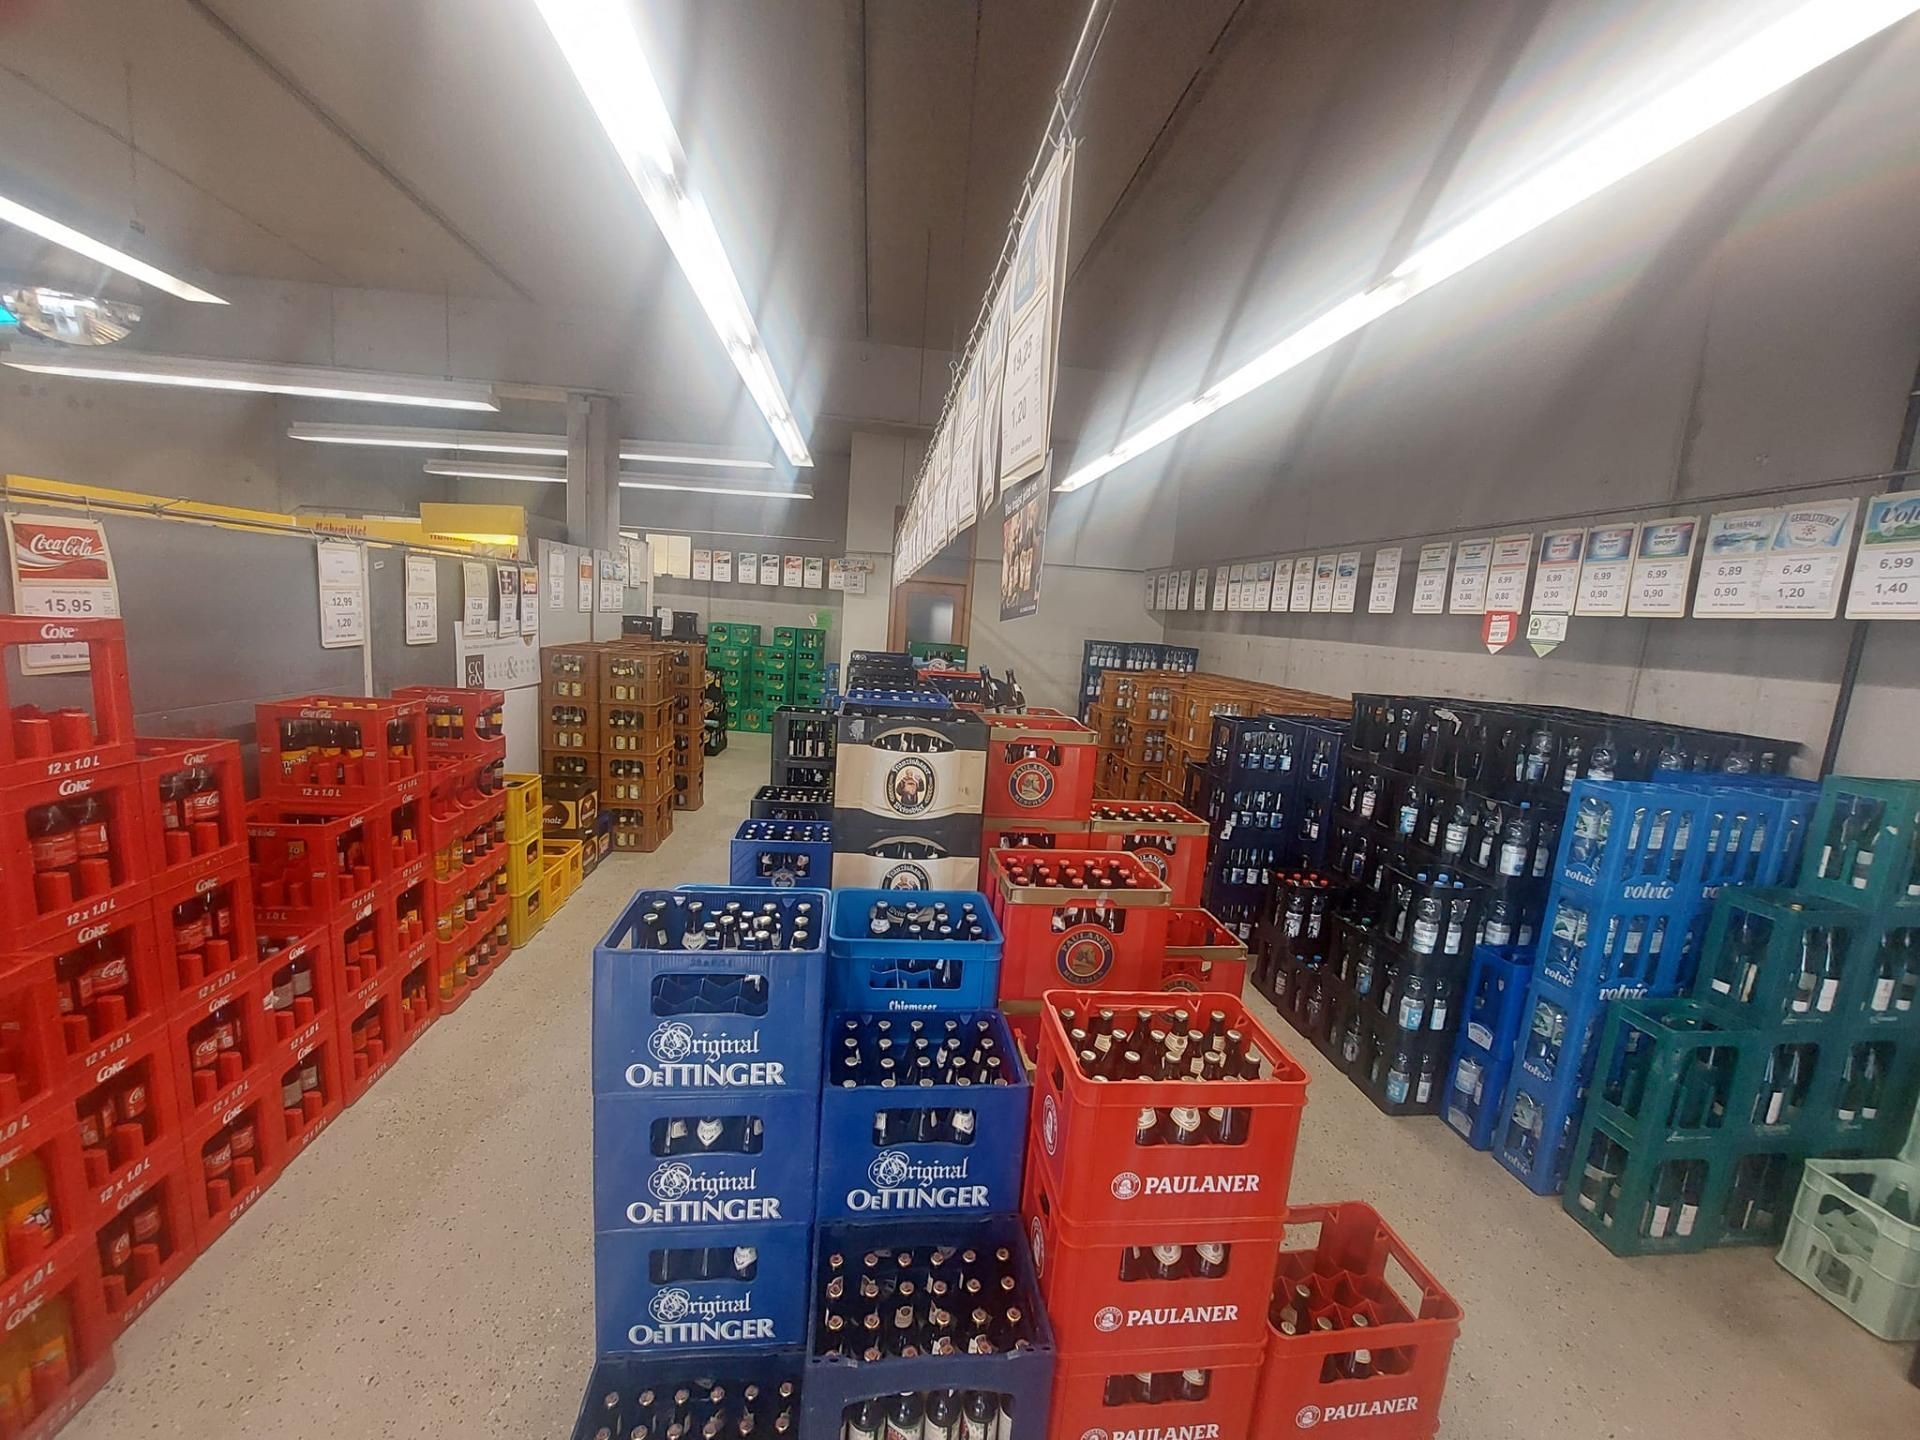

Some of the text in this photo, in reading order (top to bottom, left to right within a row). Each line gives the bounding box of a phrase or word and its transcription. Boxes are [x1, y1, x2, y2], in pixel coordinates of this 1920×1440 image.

[30, 533, 94, 556] Coca-Cola
[1718, 566, 1742, 576] 6,89
[1782, 564, 1811, 575] 6,49
[1879, 557, 1914, 570] 6,99
[1593, 572, 1611, 581] 6,99
[1647, 570, 1668, 579] 6,99
[1644, 589, 1663, 598] 0,90
[1714, 587, 1738, 597] 0,90
[1778, 588, 1805, 599] 1,20
[1874, 582, 1908, 595] 1,40
[45, 599, 92, 614] 15,95
[41, 624, 76, 640] Coke
[48, 755, 100, 775] 12 x 1.0 L
[59, 779, 92, 796] Coke
[303, 788, 312, 796] 12
[335, 789, 341, 797] L
[1565, 868, 1596, 887] volvic
[1623, 881, 1674, 900] volvic
[67, 898, 116, 926] 12 x 1.0 L
[78, 922, 110, 944] Coke
[1544, 967, 1574, 988] volvic
[1600, 983, 1648, 1000] volvic
[85, 1052, 97, 1067] 12
[99, 1049, 106, 1058] x
[125, 1033, 132, 1043] L
[648, 1020, 760, 1063] Original
[96, 1057, 128, 1083] Coke
[868, 1150, 969, 1189] Original
[100, 1185, 114, 1203] 12
[116, 1180, 123, 1192] x
[144, 1157, 151, 1169] L
[648, 1161, 757, 1201] Original
[1144, 1174, 1260, 1195] PAULANER
[648, 1287, 752, 1324] Original
[1126, 1304, 1239, 1327] PAULANER
[1323, 1396, 1418, 1422] PAULANER
